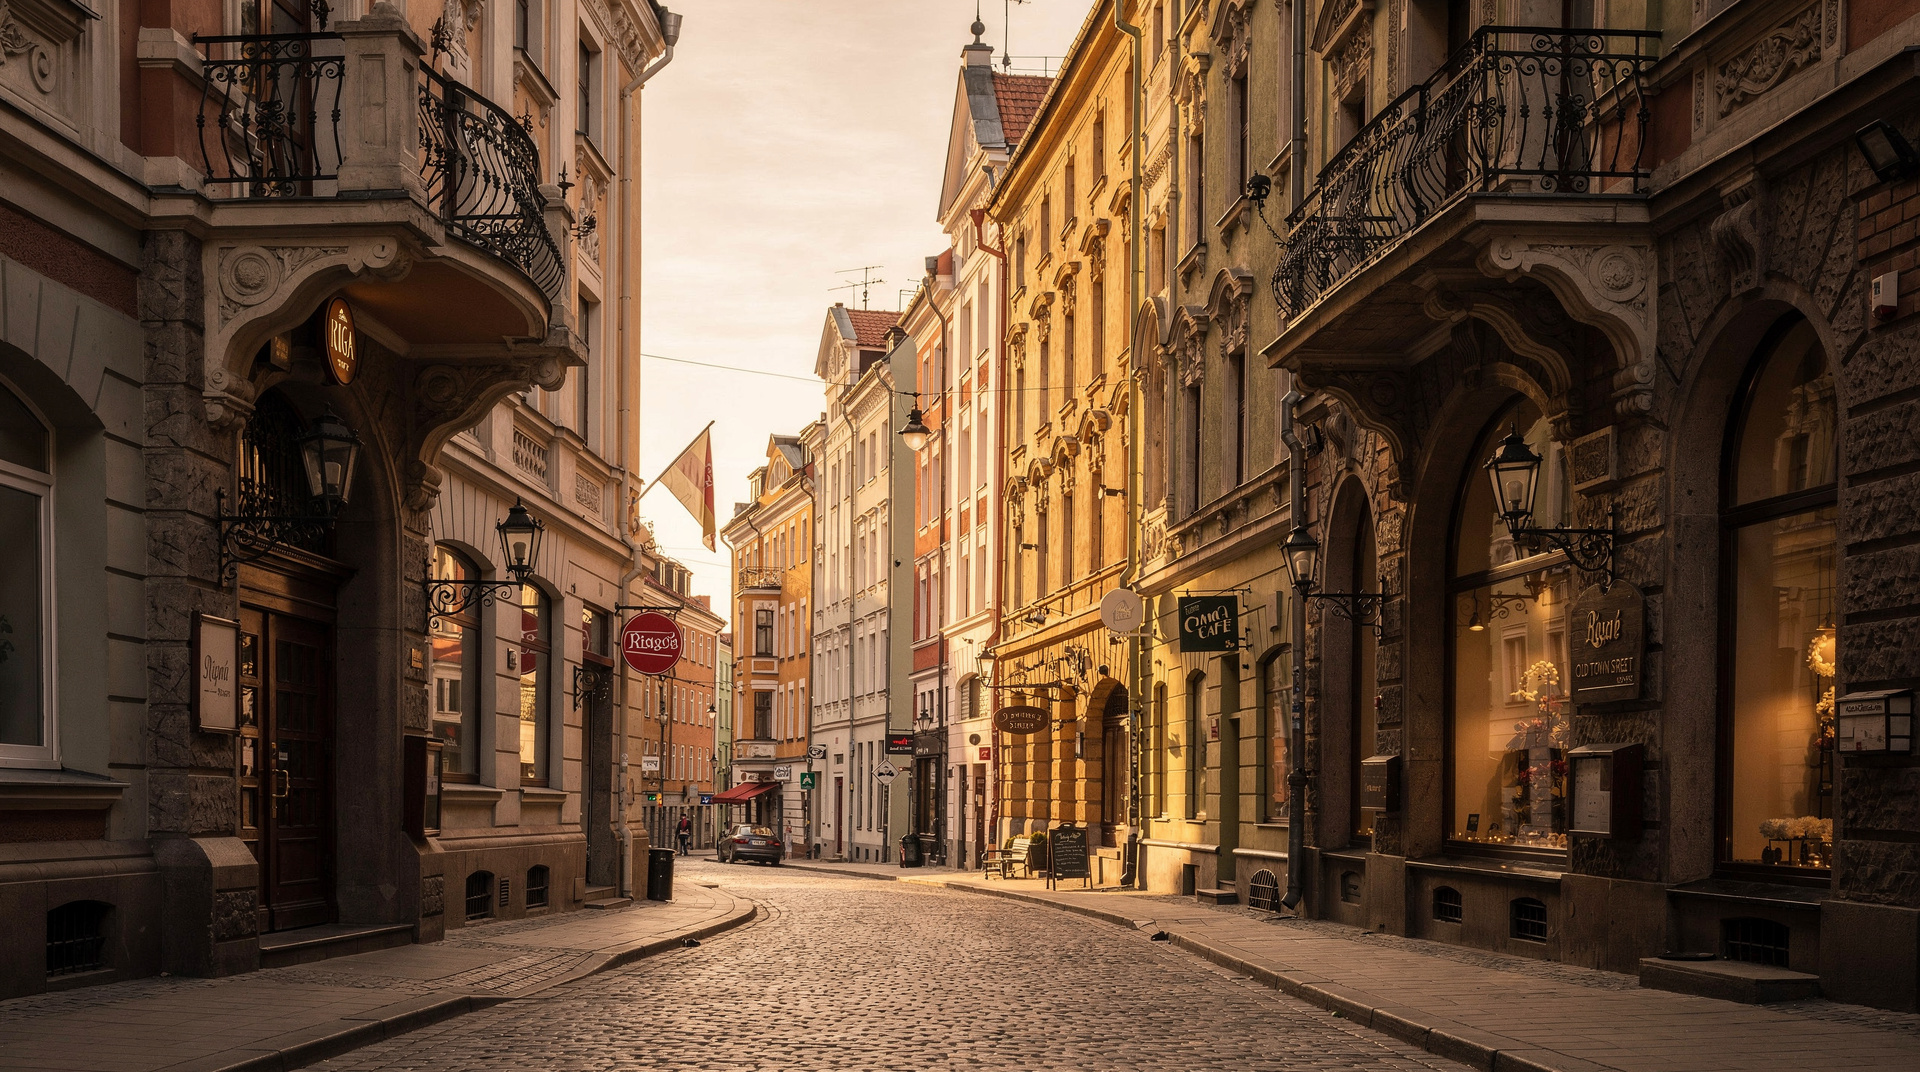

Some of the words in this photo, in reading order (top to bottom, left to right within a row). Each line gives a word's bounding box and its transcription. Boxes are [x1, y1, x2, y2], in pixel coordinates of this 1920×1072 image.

[331, 318, 354, 360] RIGA
[1198, 619, 1232, 639] CAFE
[1575, 663, 1589, 678] OLD
[1611, 657, 1634, 674] SREET
